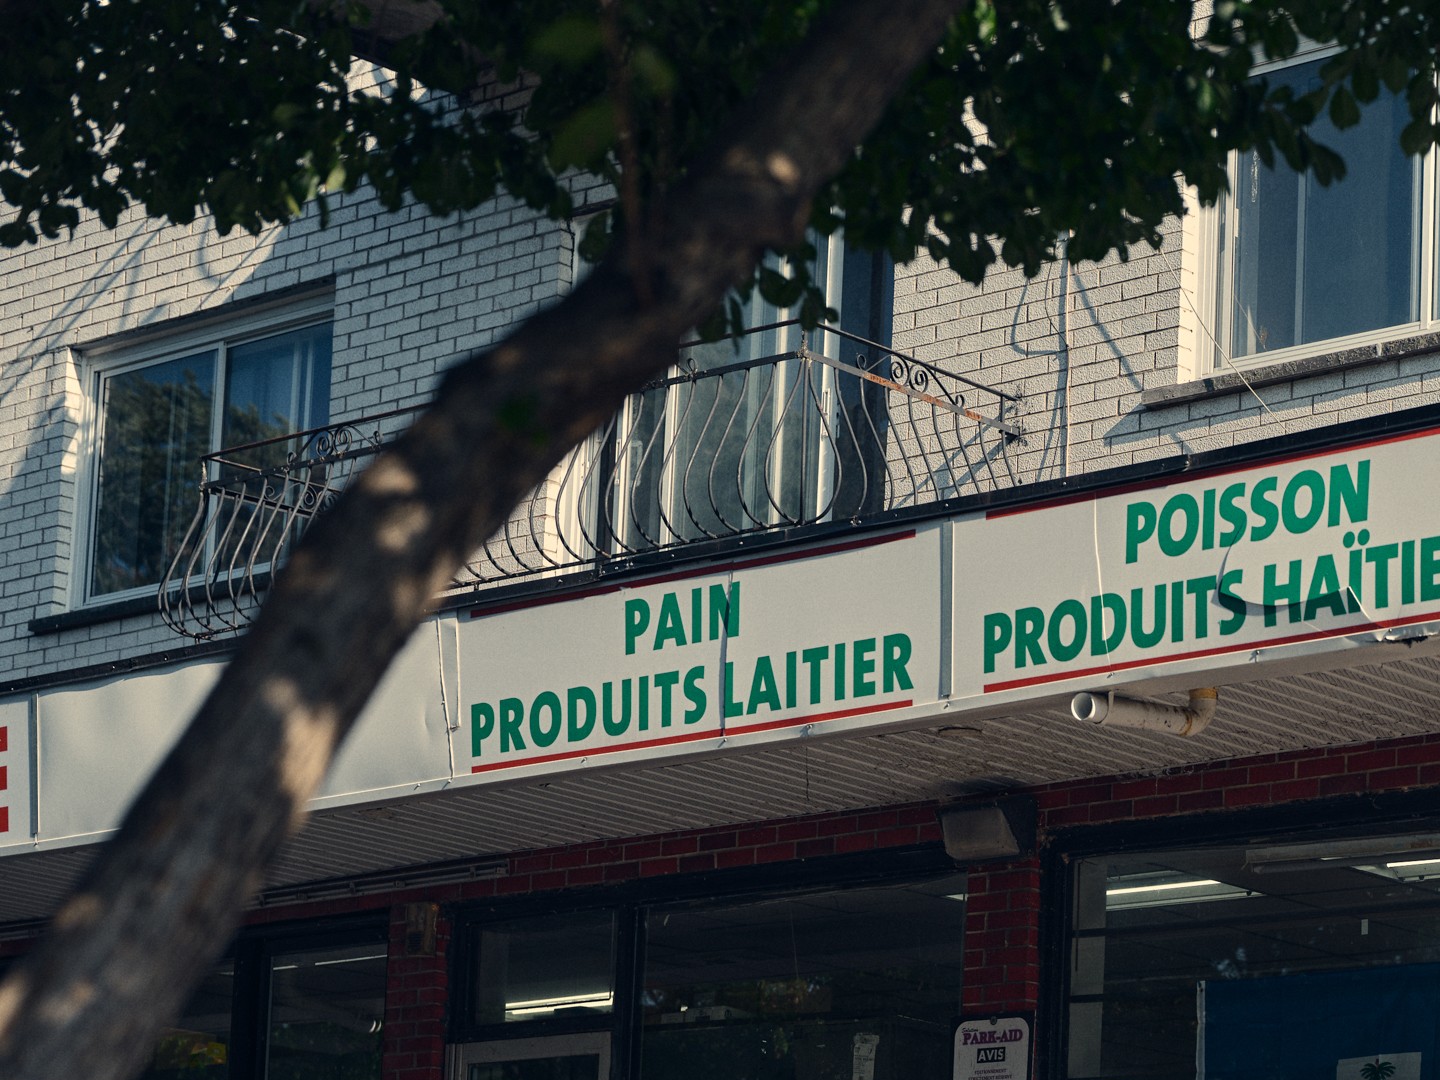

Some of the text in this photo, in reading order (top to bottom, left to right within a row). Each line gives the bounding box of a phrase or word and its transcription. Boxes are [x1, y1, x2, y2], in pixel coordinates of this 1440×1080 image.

[1125, 458, 1371, 565] POISSON
[624, 581, 740, 655] PAIN
[983, 568, 1244, 674] PRODUITS
[470, 632, 915, 758] PRODUITS LAITIER
[962, 1029, 1023, 1046] PARK-AID
[978, 1049, 1004, 1062] AVIS
